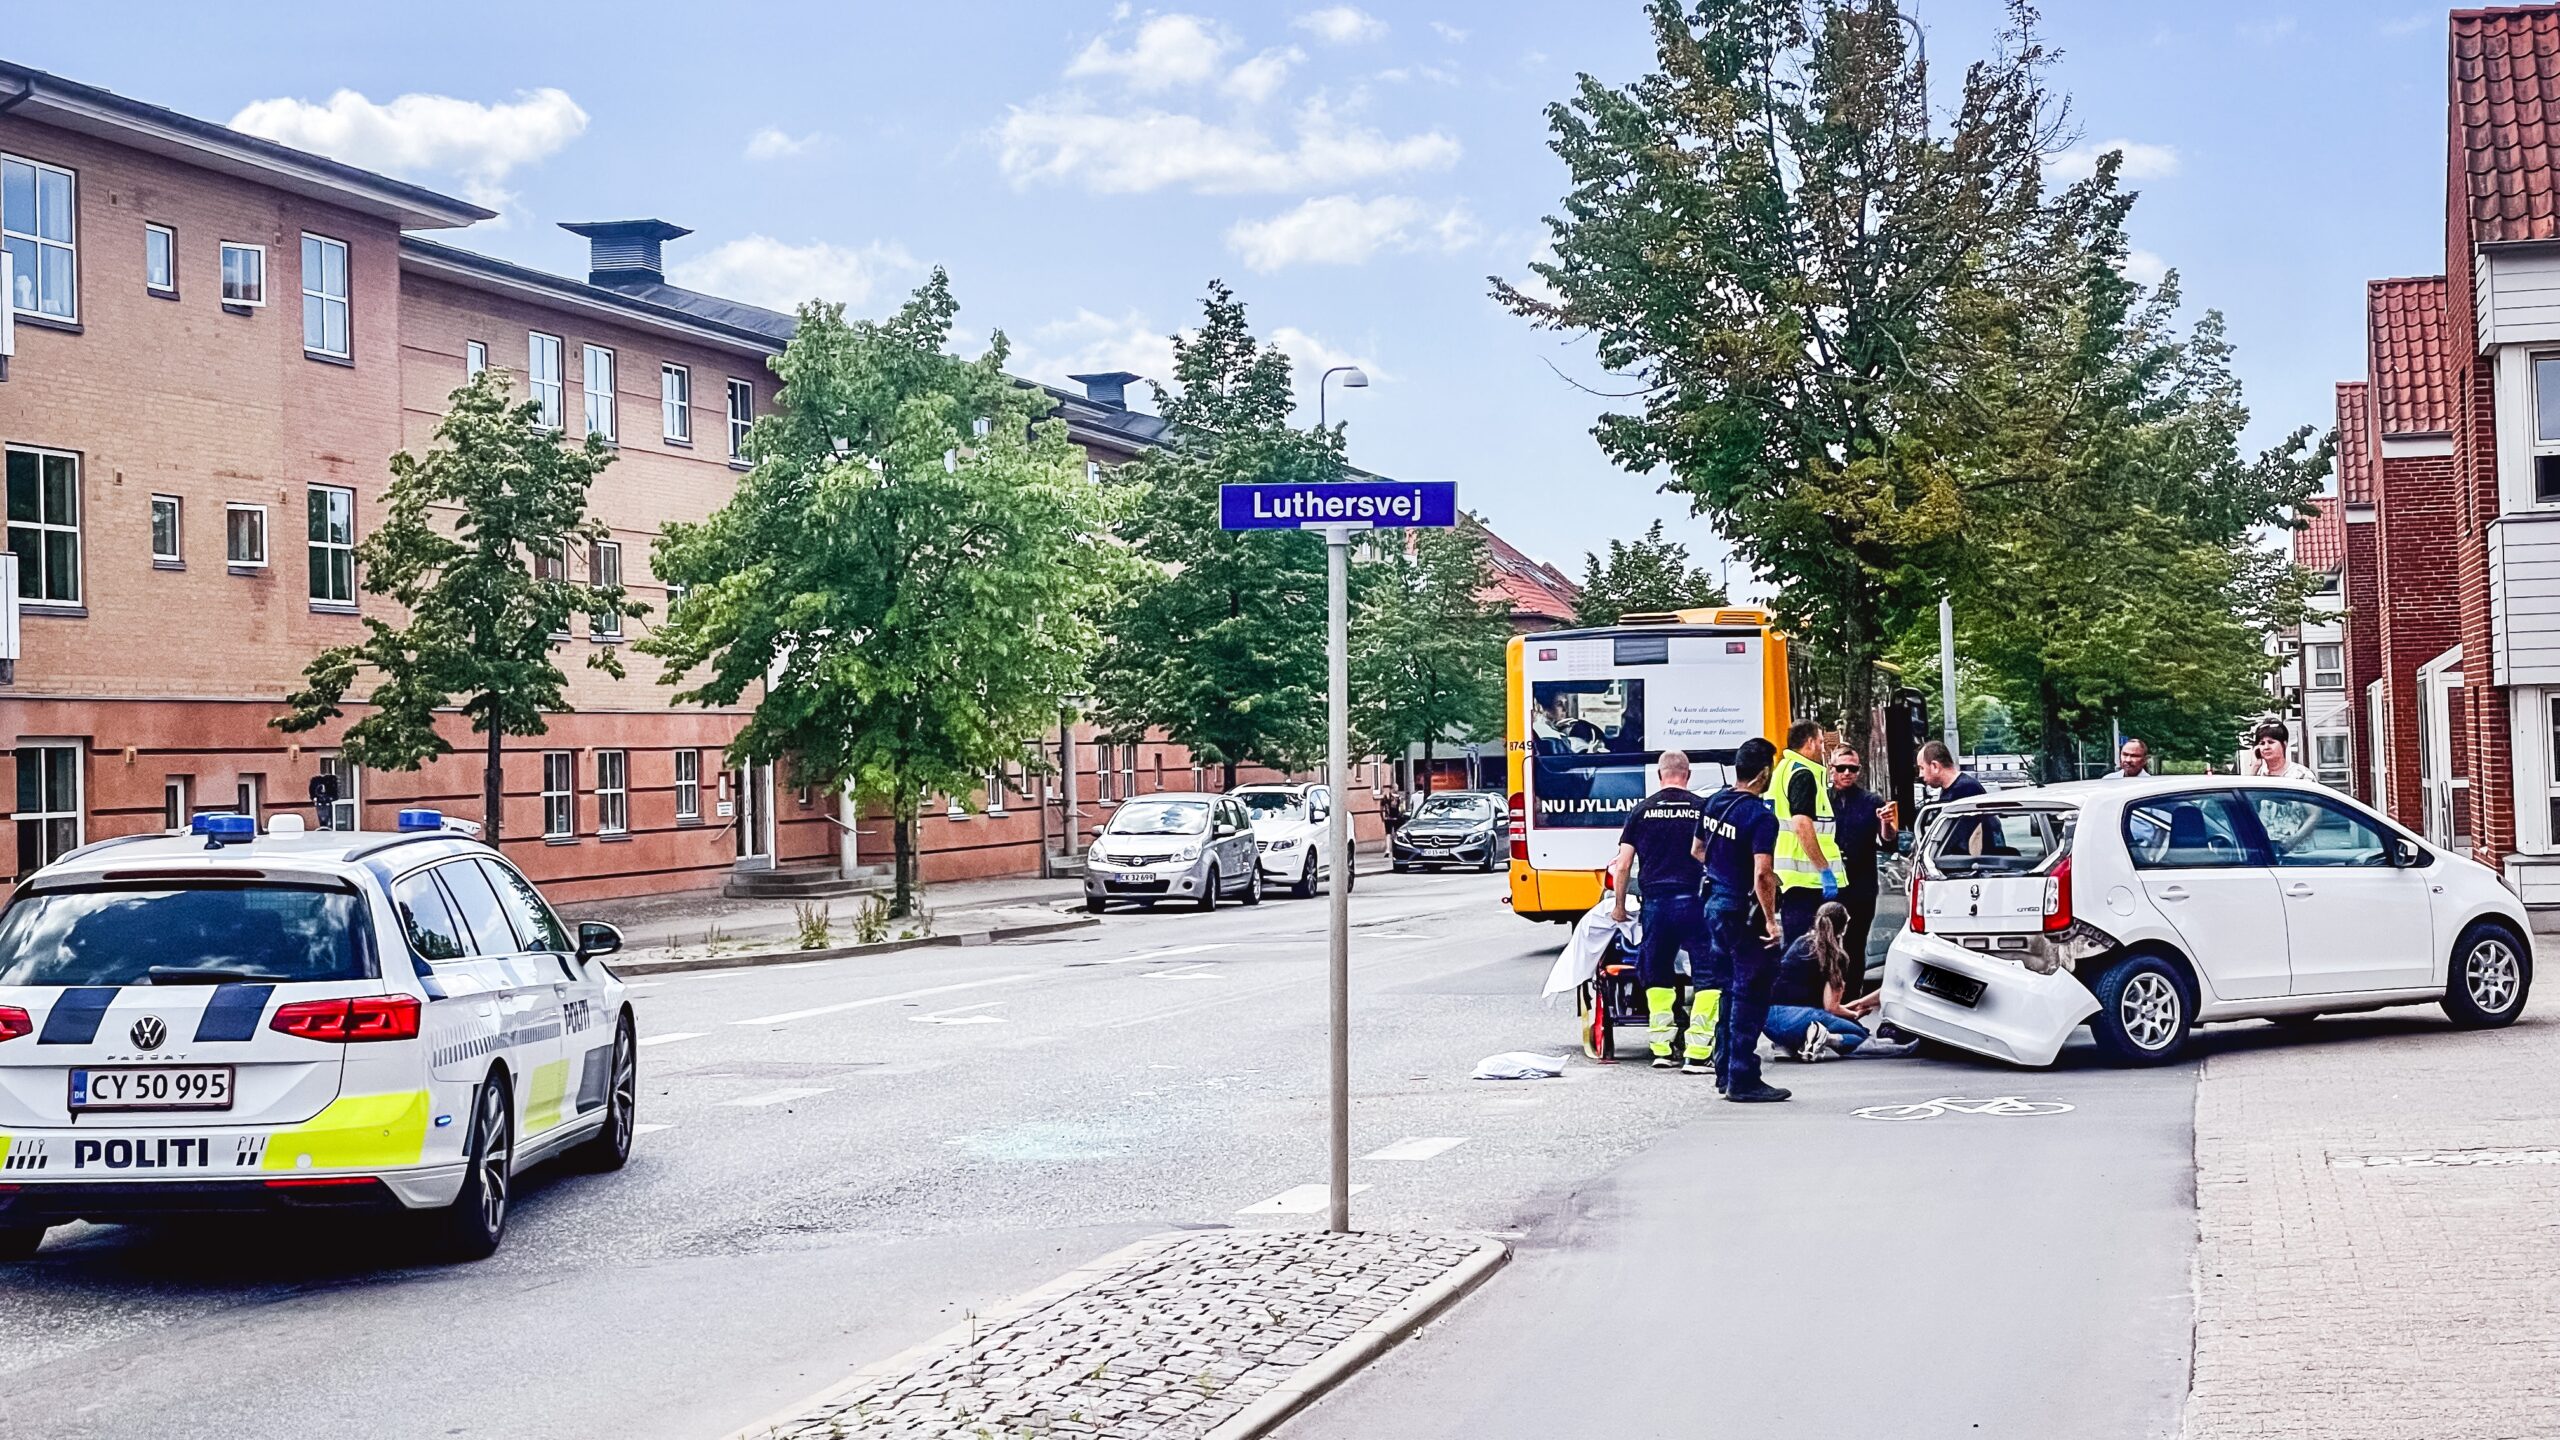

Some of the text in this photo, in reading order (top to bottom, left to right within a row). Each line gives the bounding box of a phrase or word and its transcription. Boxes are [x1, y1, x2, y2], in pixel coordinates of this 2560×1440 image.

[1253, 489, 1421, 521] Luthersvej
[1509, 741, 1533, 751] 8749
[1541, 798, 1646, 813] NU I JYLLAN
[1643, 809, 1700, 819] AMBULANCE
[563, 999, 590, 1035] POLITI
[74, 1091, 85, 1099] DK
[91, 1073, 226, 1099] CY 50 995
[74, 1138, 209, 1168] POLITI
